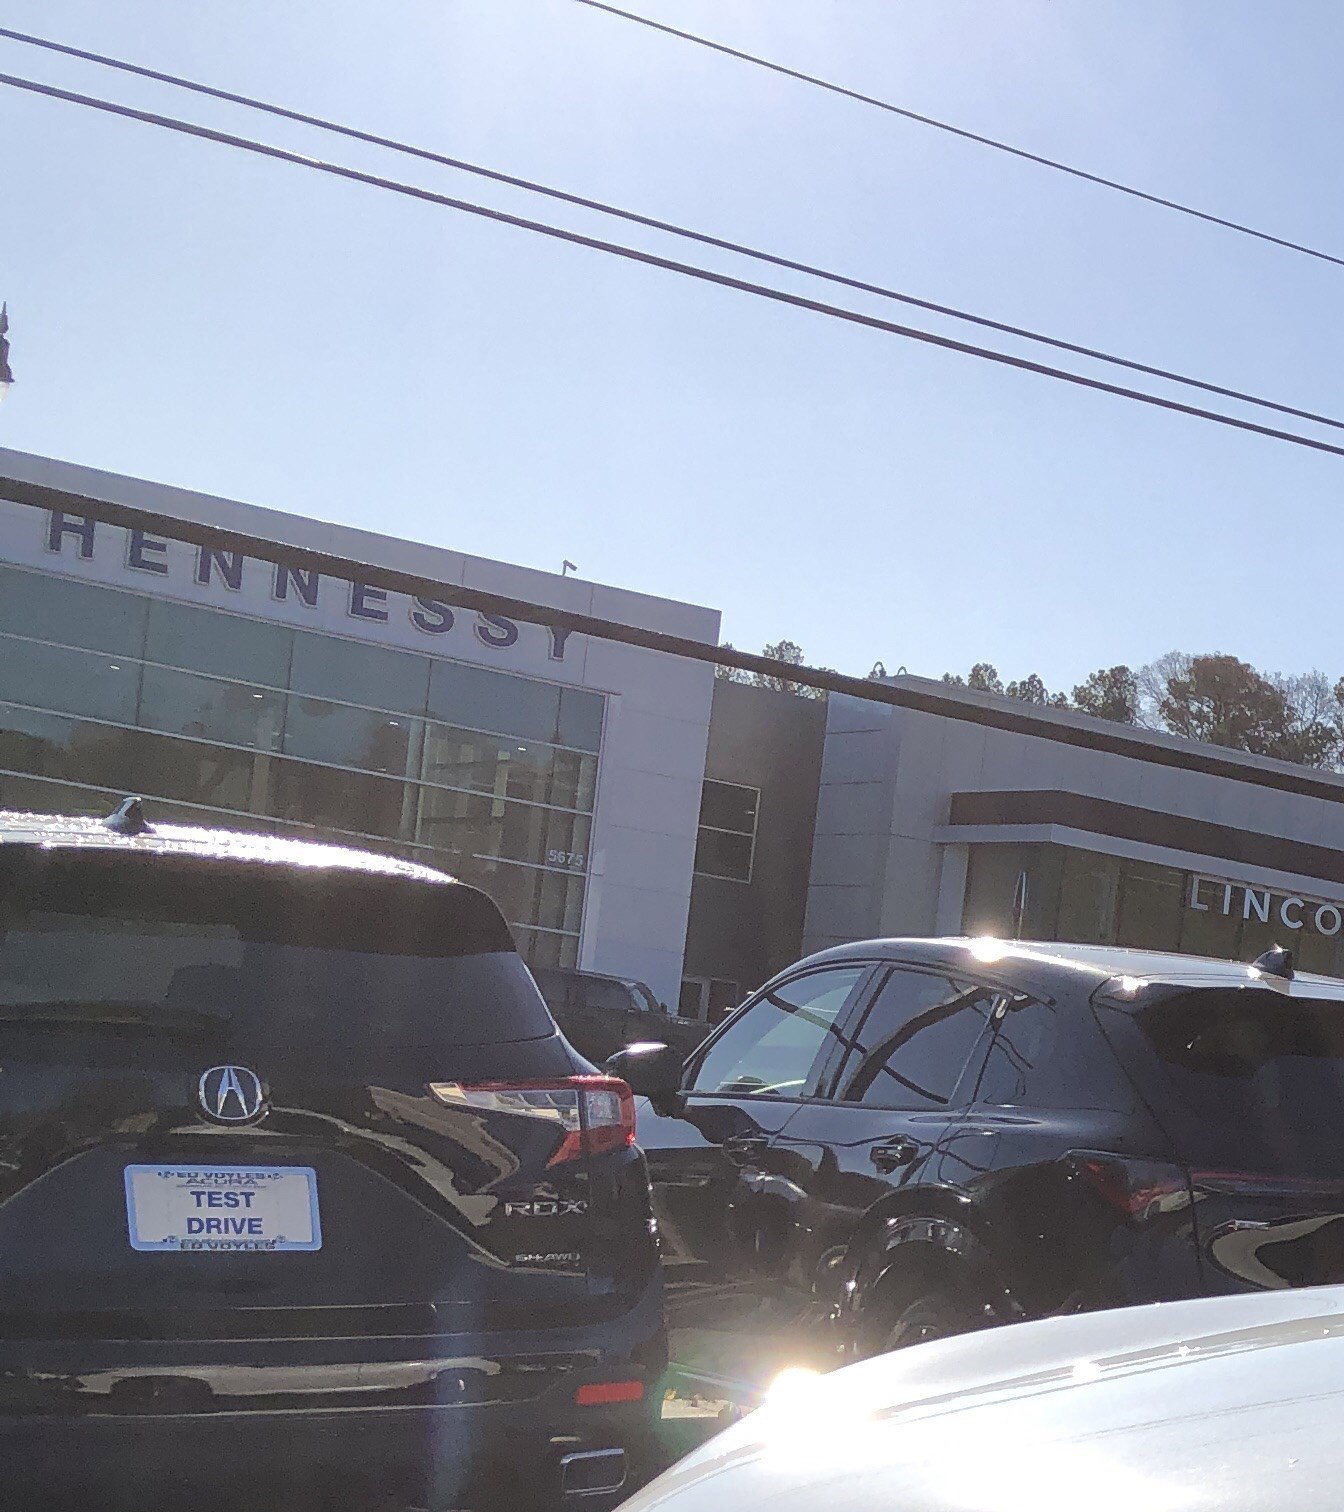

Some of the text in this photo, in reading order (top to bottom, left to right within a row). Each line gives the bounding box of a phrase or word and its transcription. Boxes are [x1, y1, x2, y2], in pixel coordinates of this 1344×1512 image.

[46, 509, 576, 660] HENNESSY
[549, 849, 584, 867] 5675
[185, 1178, 259, 1186] ACURA
[189, 1190, 256, 1209] TEST
[505, 1200, 588, 1216] RDX
[186, 1216, 264, 1235] DRIVE
